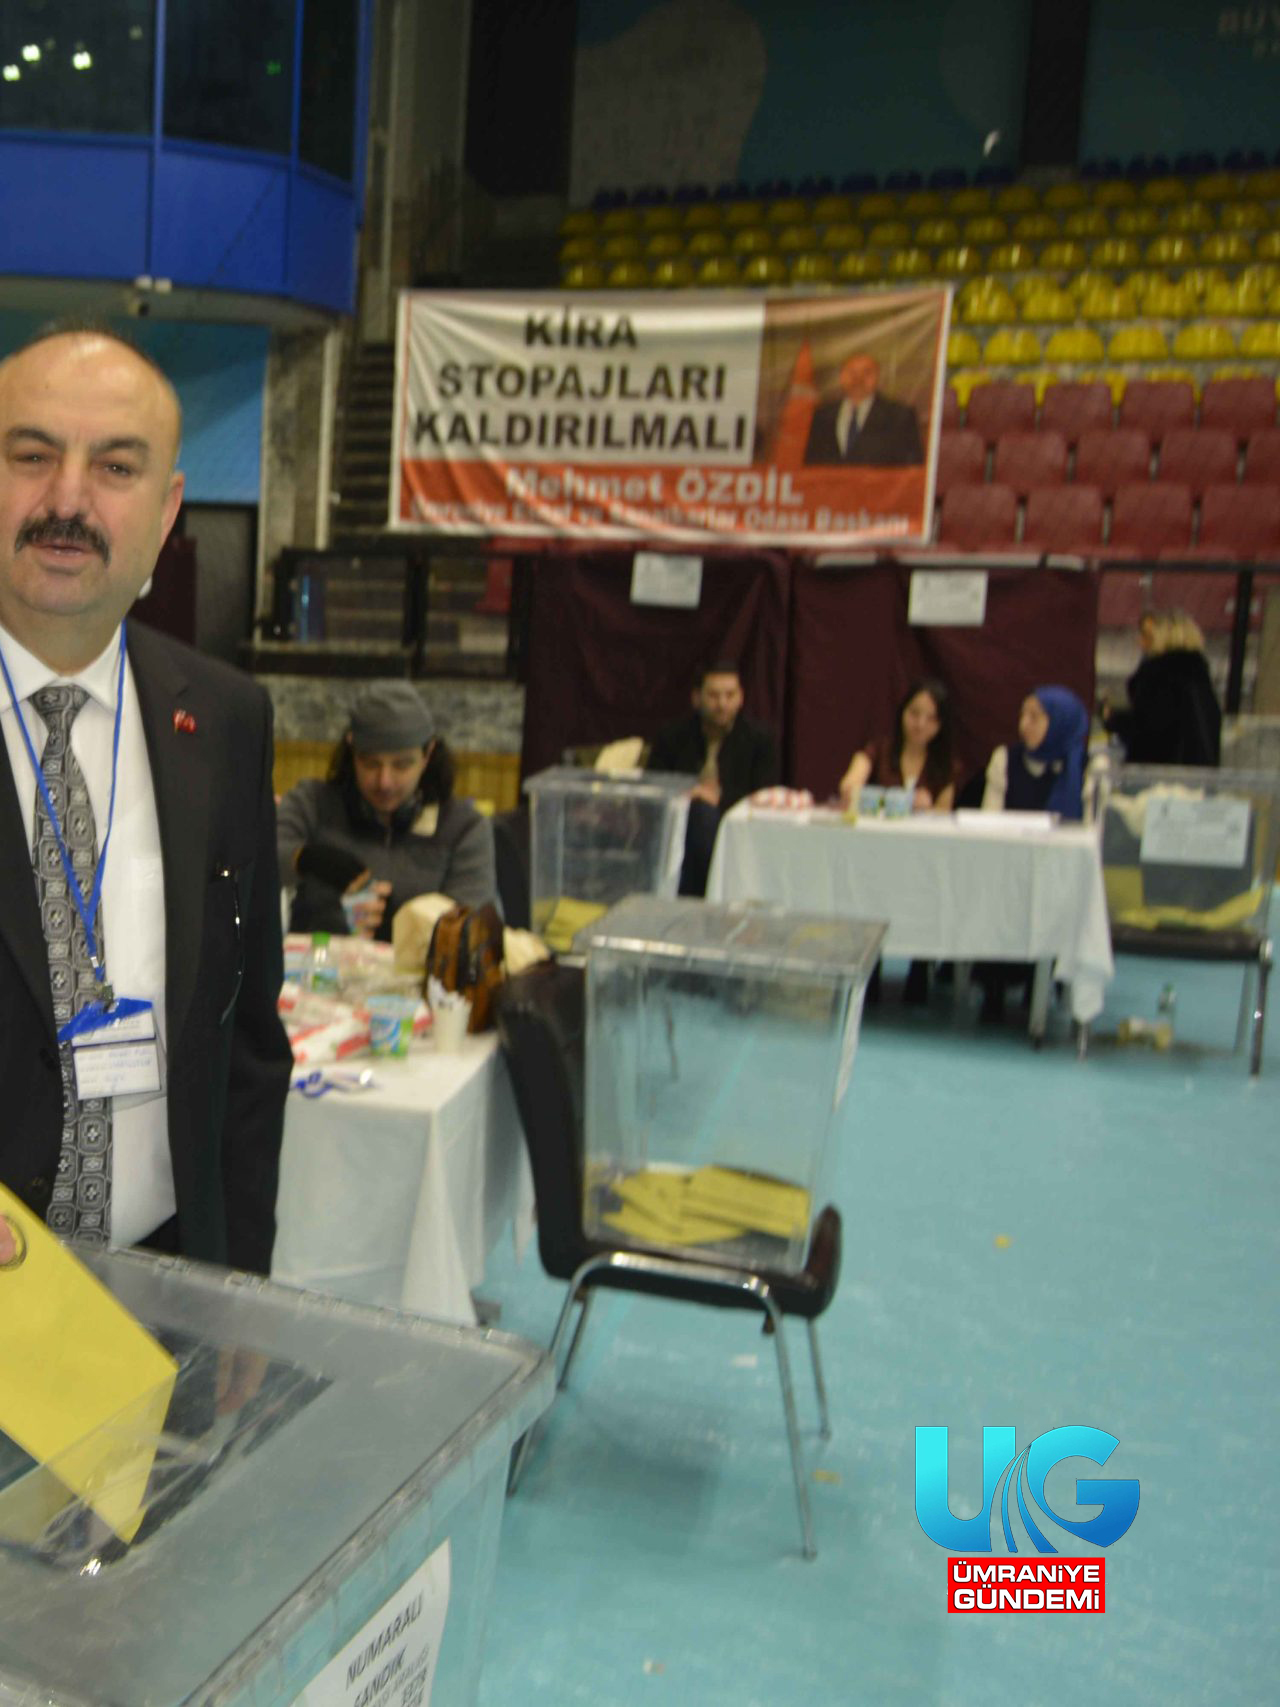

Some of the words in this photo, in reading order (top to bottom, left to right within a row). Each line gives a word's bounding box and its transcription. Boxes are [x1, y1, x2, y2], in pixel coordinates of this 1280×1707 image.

[525, 304, 638, 349] KİRA
[438, 363, 728, 400] STOPAJLARI
[415, 411, 746, 449] KALDIRILMALI
[505, 467, 663, 504] Mehmet
[676, 466, 804, 506] ÖZDİL
[345, 1589, 424, 1692] NUMARALI
